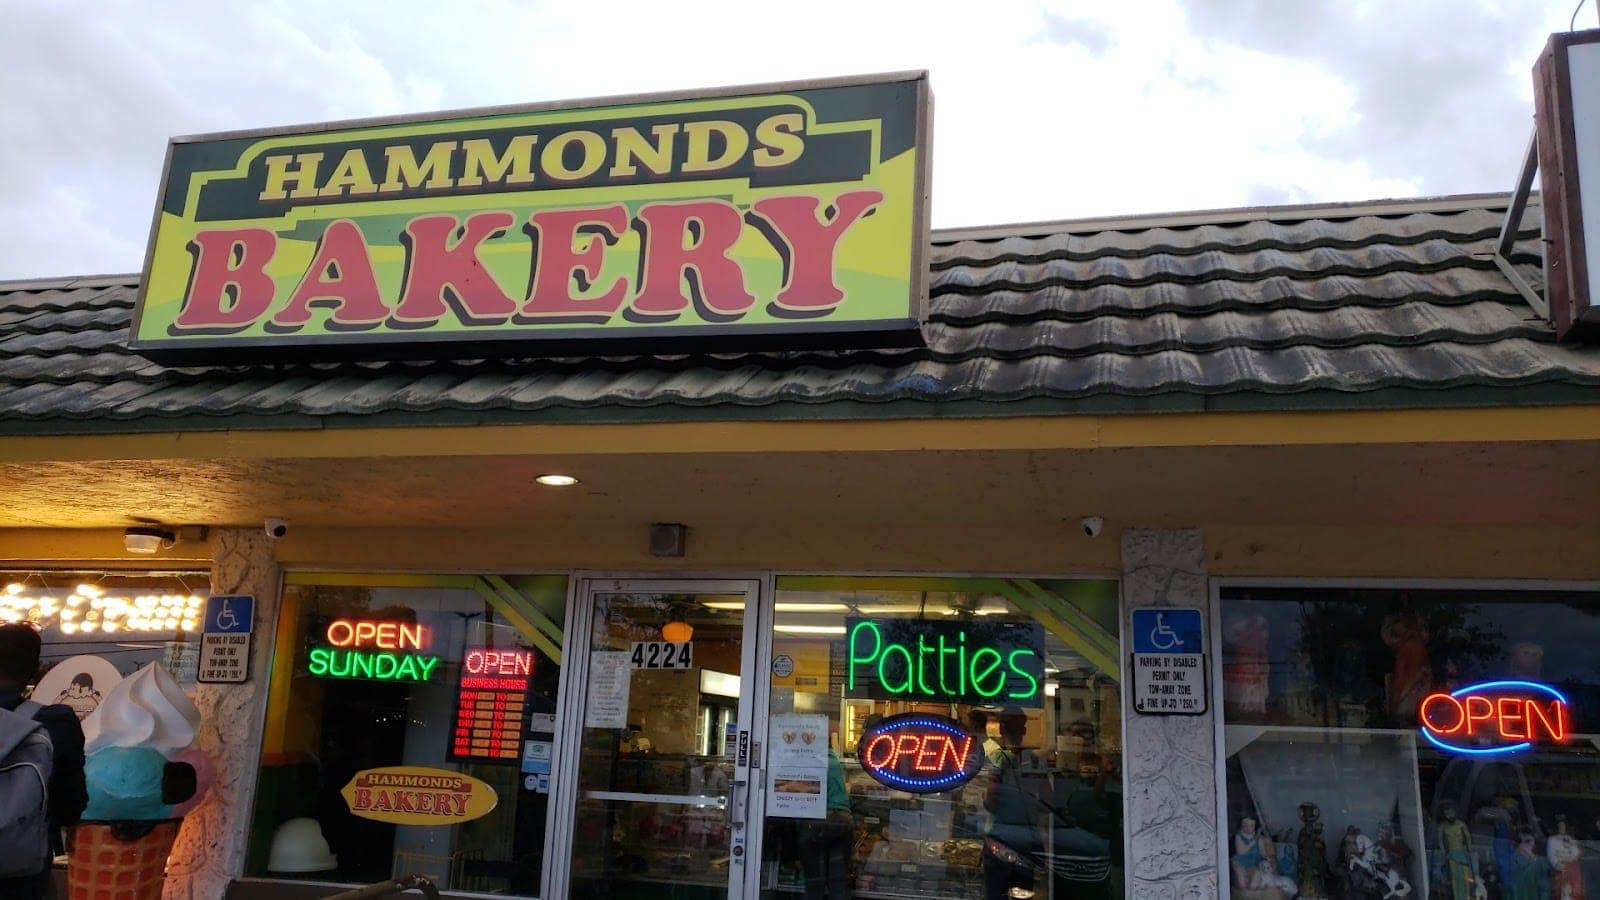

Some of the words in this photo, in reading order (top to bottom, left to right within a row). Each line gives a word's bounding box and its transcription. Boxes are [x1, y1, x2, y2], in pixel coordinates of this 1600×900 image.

[258, 111, 806, 203] HAMMONDS
[170, 189, 883, 333] BAKERY
[327, 620, 422, 650] OPEN
[631, 642, 691, 668] 4224
[850, 621, 1037, 698] Patties
[1139, 657, 1161, 667] PARKING
[1163, 657, 1170, 667] BY
[1173, 657, 1197, 667] DISABLED
[308, 649, 437, 681] SUNDAY
[466, 651, 532, 675] OPEN
[1152, 671, 1170, 681] PERMIT
[1173, 671, 1186, 681] ONLY
[461, 677, 499, 688] BUSINESS
[500, 679, 527, 690] HOURS
[1148, 684, 1175, 695] TOW-AWAY
[1178, 685, 1192, 695] ZONE
[460, 691, 477, 700] MON
[496, 693, 506, 701] TO
[1147, 698, 1158, 708] FINE
[1161, 698, 1168, 708] UP
[495, 702, 505, 710] TO
[494, 711, 504, 719] TO
[1420, 693, 1564, 741] OPEN
[493, 720, 503, 728] TO
[492, 730, 502, 738] TO
[491, 739, 500, 747] TO
[866, 733, 973, 772] OPEN
[367, 774, 463, 789] HAMMONDS
[352, 788, 473, 816] BAKERY
